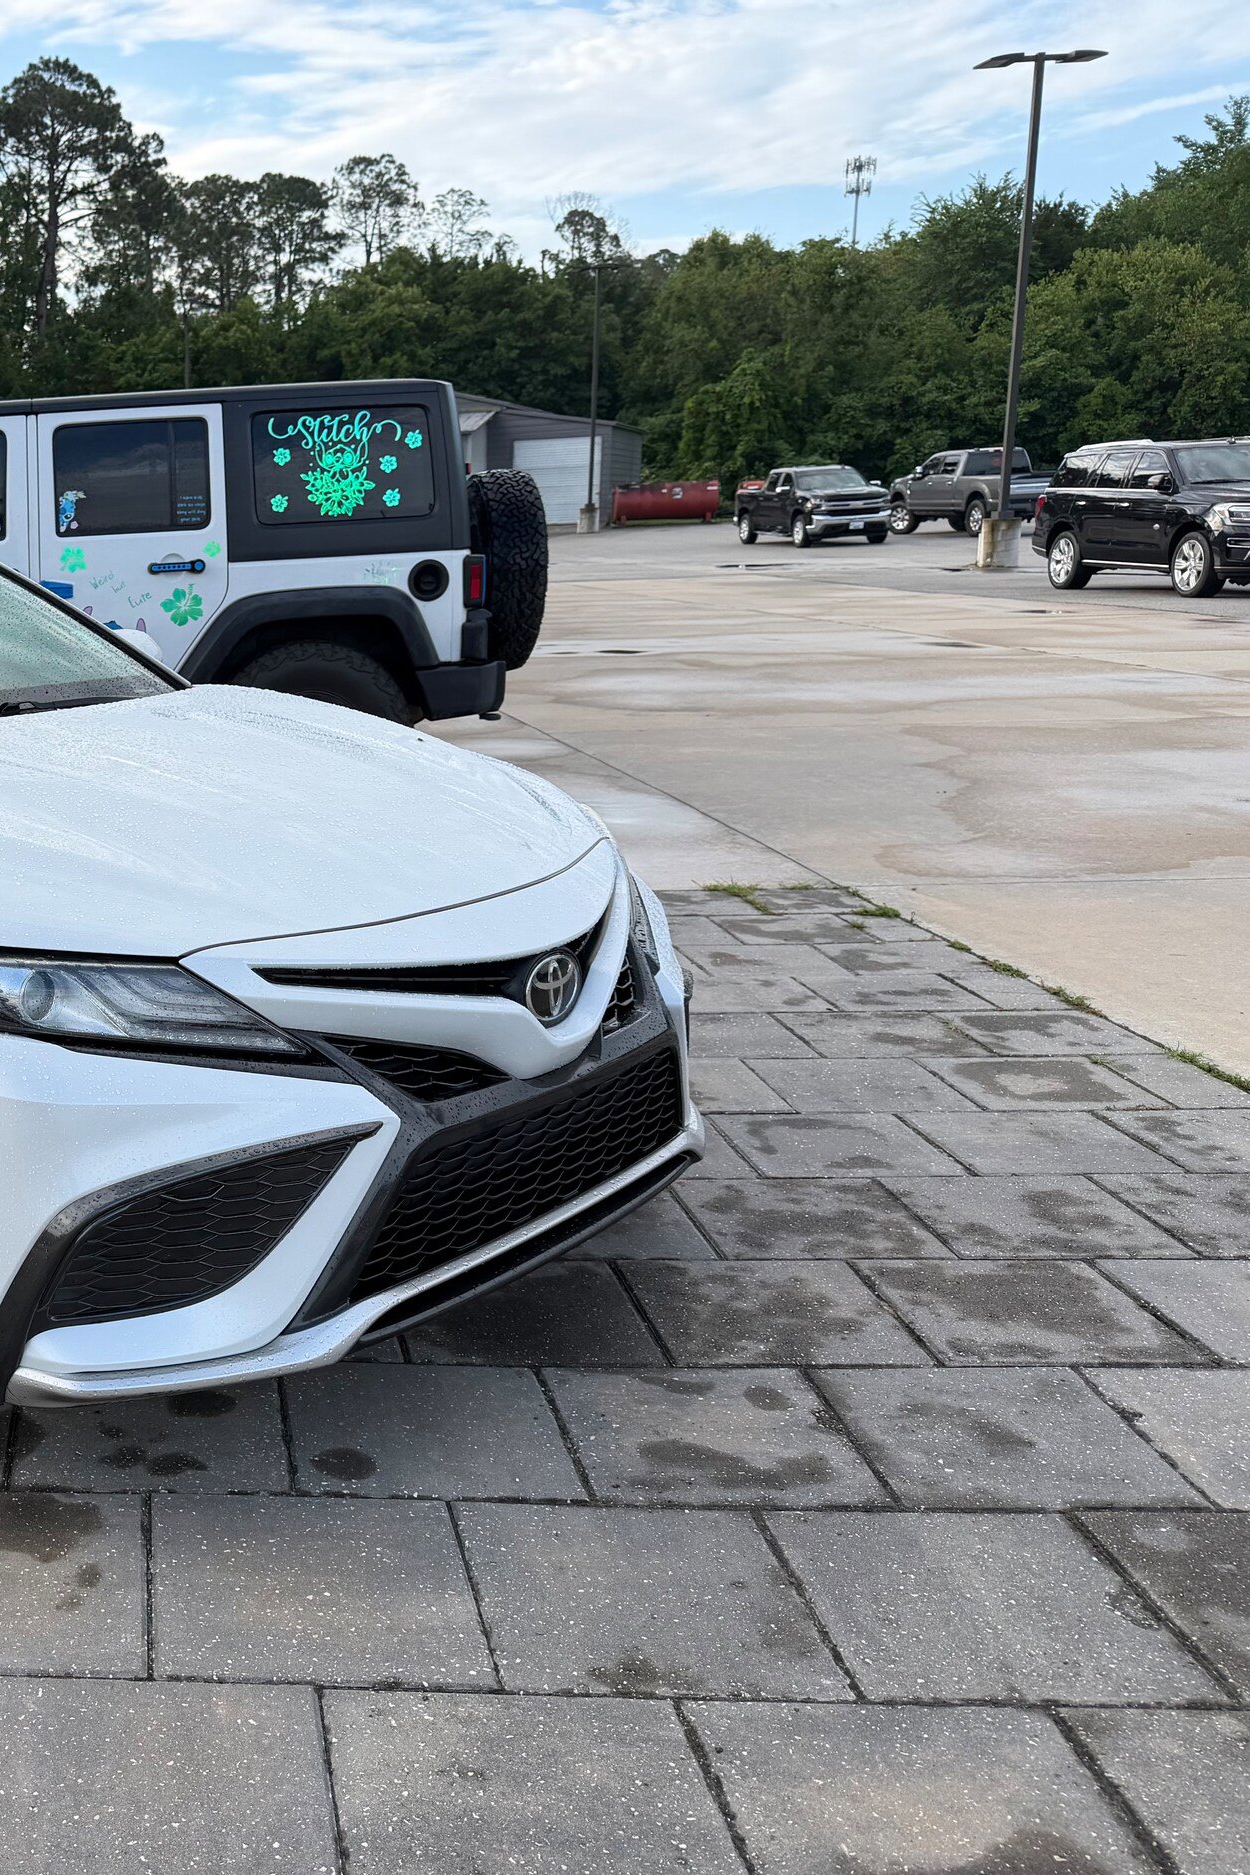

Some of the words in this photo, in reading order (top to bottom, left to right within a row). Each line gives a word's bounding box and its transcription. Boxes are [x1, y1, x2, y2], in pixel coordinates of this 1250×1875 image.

[268, 410, 402, 449] Stitch
[89, 569, 115, 590] Weird
[127, 592, 152, 608] Cute
